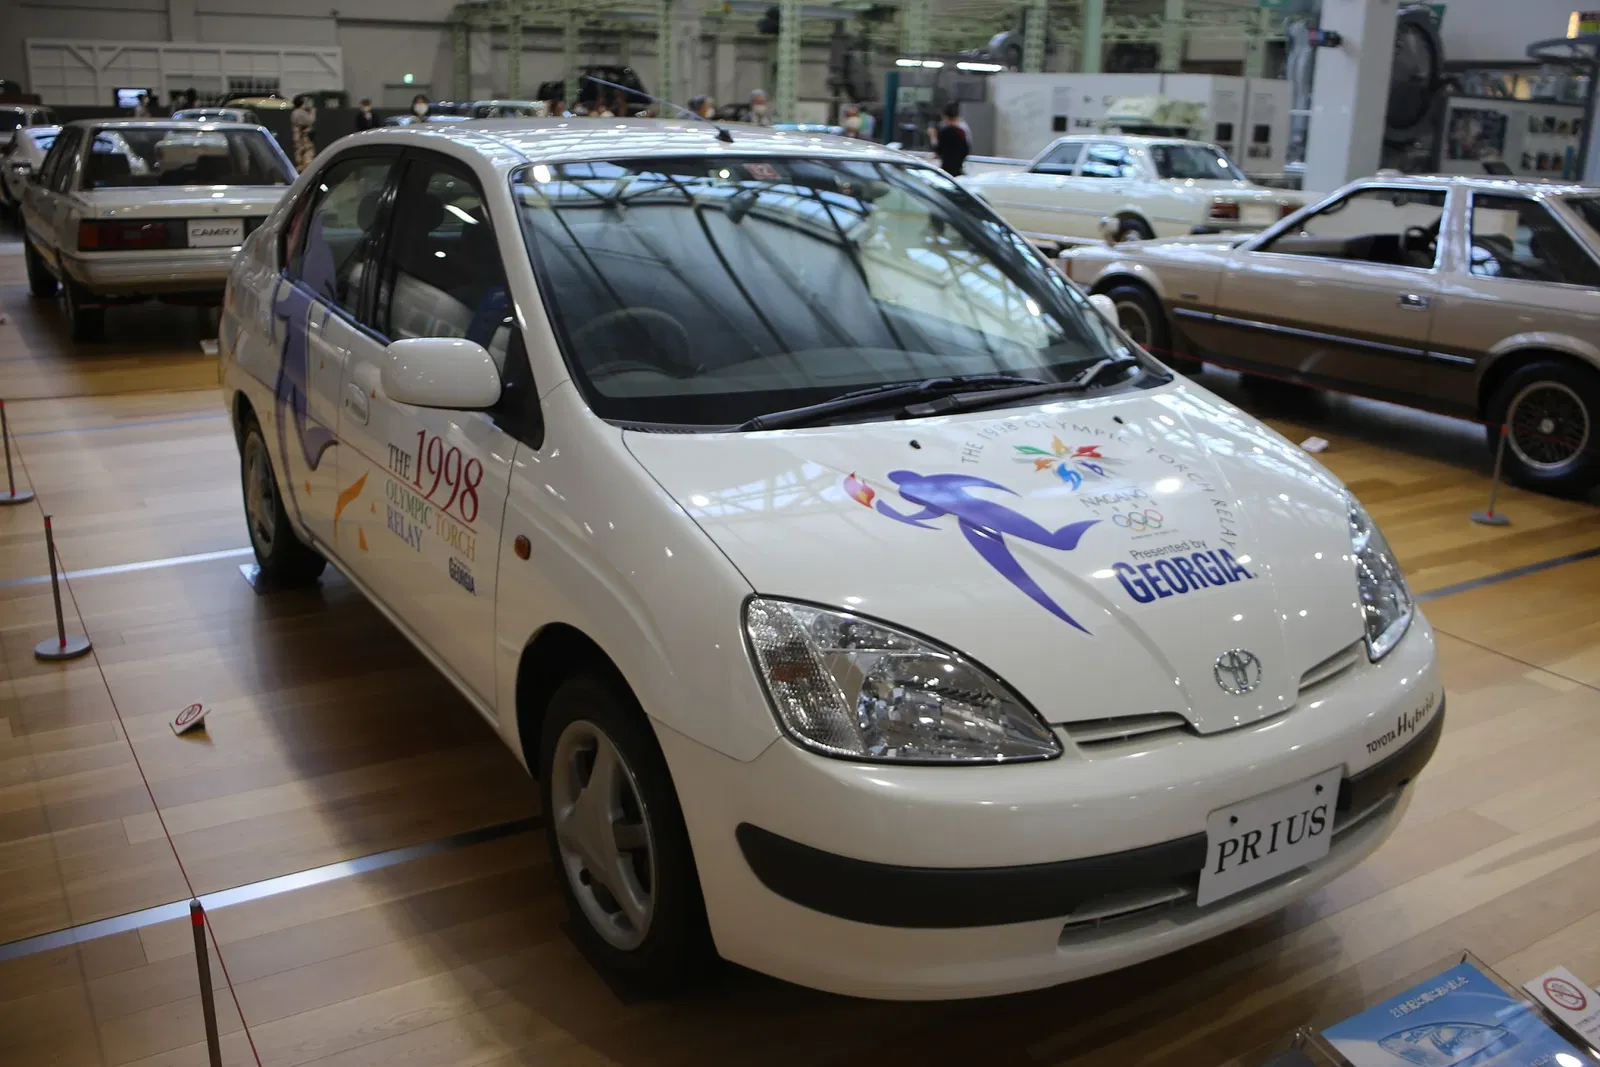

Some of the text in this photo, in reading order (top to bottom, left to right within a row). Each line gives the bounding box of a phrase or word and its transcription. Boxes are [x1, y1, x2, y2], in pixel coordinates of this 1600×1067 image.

[191, 227, 239, 237] CAMRY
[961, 441, 984, 464] THE
[976, 421, 1019, 441] 1998
[387, 429, 484, 523] THE 1998
[386, 479, 476, 562] OLYMPIC TORCH
[386, 504, 423, 552] RELAY
[1111, 548, 1253, 604] GEORGIA
[1129, 539, 1207, 561] Presented by
[1366, 691, 1434, 754] TOYOTA Hybrid
[1214, 803, 1328, 875] PRIUS
